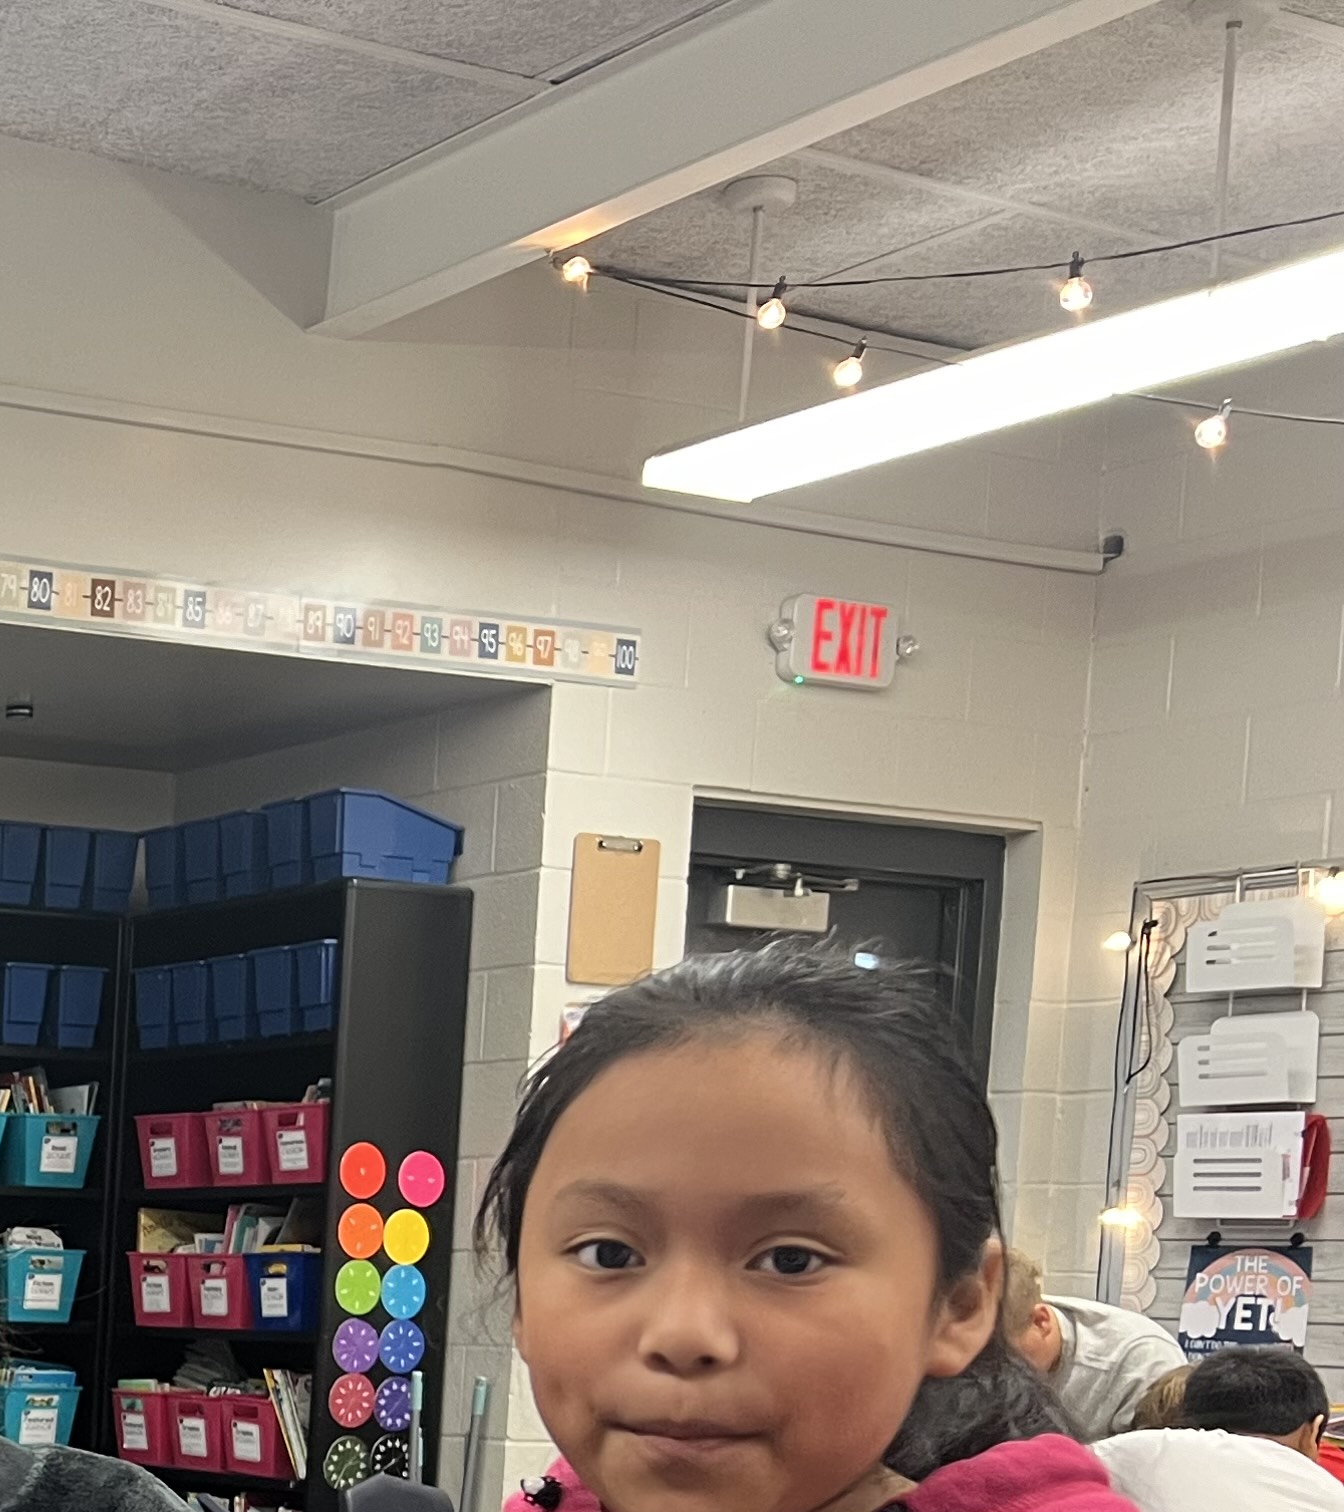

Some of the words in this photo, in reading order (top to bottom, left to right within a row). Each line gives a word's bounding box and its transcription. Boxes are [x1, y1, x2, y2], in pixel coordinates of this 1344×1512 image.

[1, 573, 17, 598] 79
[32, 577, 50, 602] 80
[95, 586, 111, 611] 82
[127, 589, 143, 614] 83
[187, 597, 202, 622] 85
[307, 609, 323, 634] 89
[336, 613, 353, 638] 90
[367, 616, 380, 641] 91
[395, 619, 410, 643] 92
[424, 622, 439, 647] 93
[453, 625, 469, 650] 94
[481, 629, 496, 653] 95
[509, 632, 523, 656] 96
[536, 636, 551, 659] 97
[616, 645, 634, 669] 100
[811, 598, 888, 679] EXIT
[1195, 1273, 1268, 1295] POWER
[1277, 1276, 1303, 1296] OF
[1236, 1255, 1268, 1273] THE
